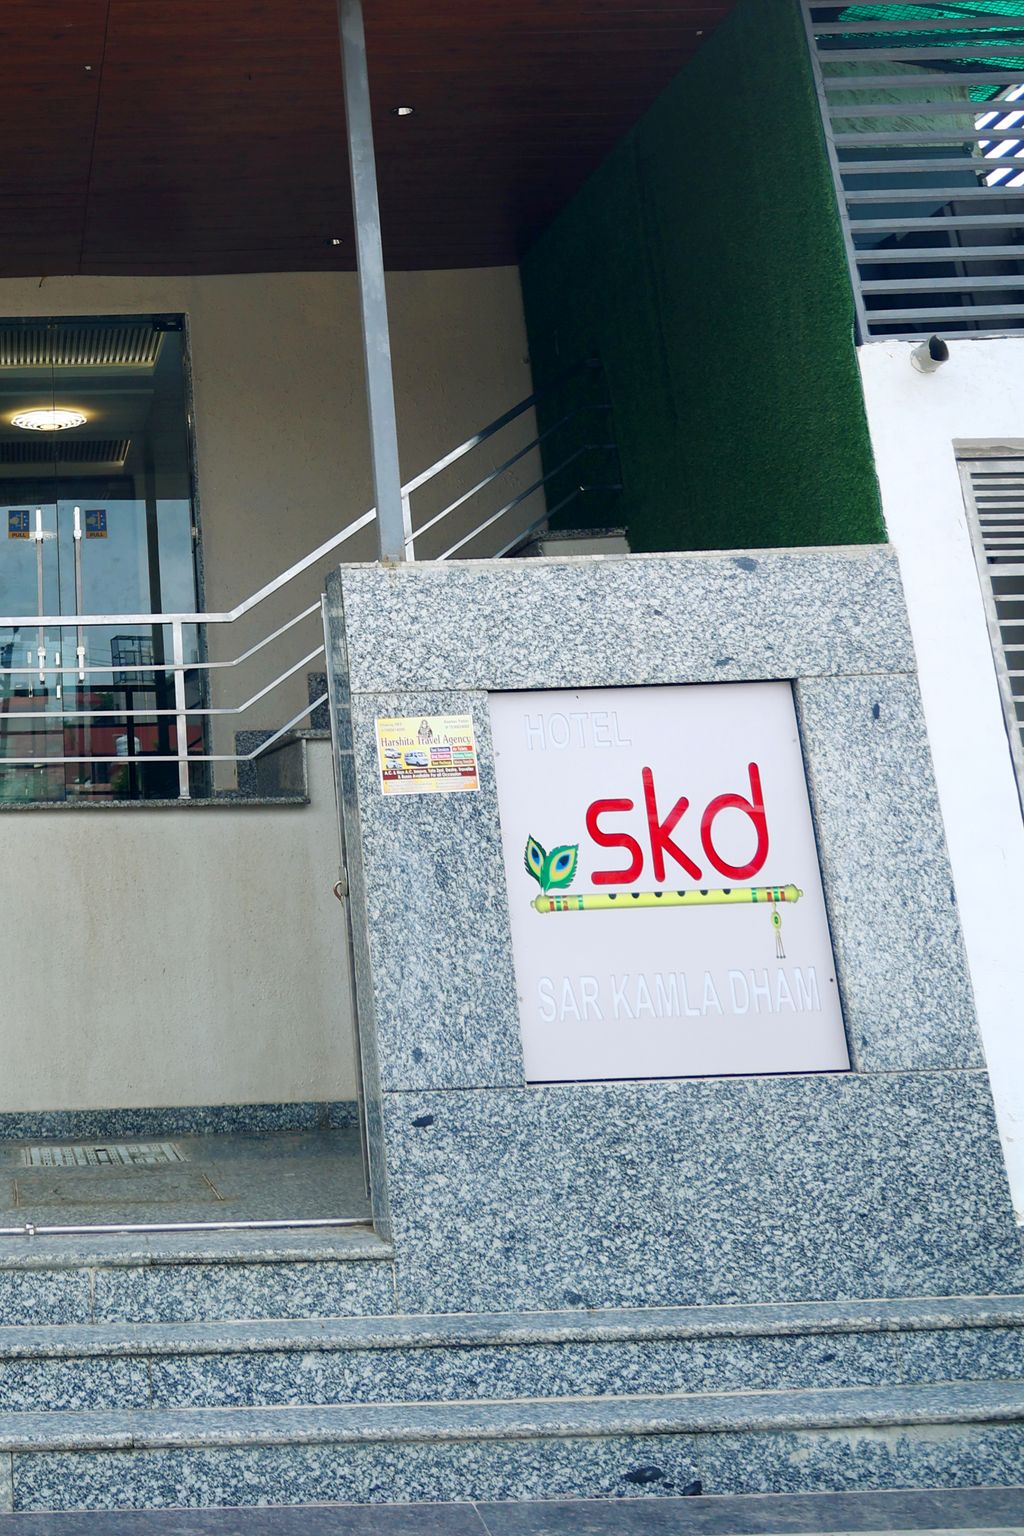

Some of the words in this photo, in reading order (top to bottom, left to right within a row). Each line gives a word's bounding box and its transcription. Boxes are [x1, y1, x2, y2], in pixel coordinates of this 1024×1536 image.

[381, 737, 414, 747] Harshita
[416, 734, 440, 745] Travel
[443, 734, 471, 745] Agency
[524, 711, 632, 751] HOTEL
[586, 761, 769, 886] skd
[537, 975, 604, 1023] SAR
[610, 970, 724, 1020] KAMLA
[728, 966, 822, 1015] DHAM
